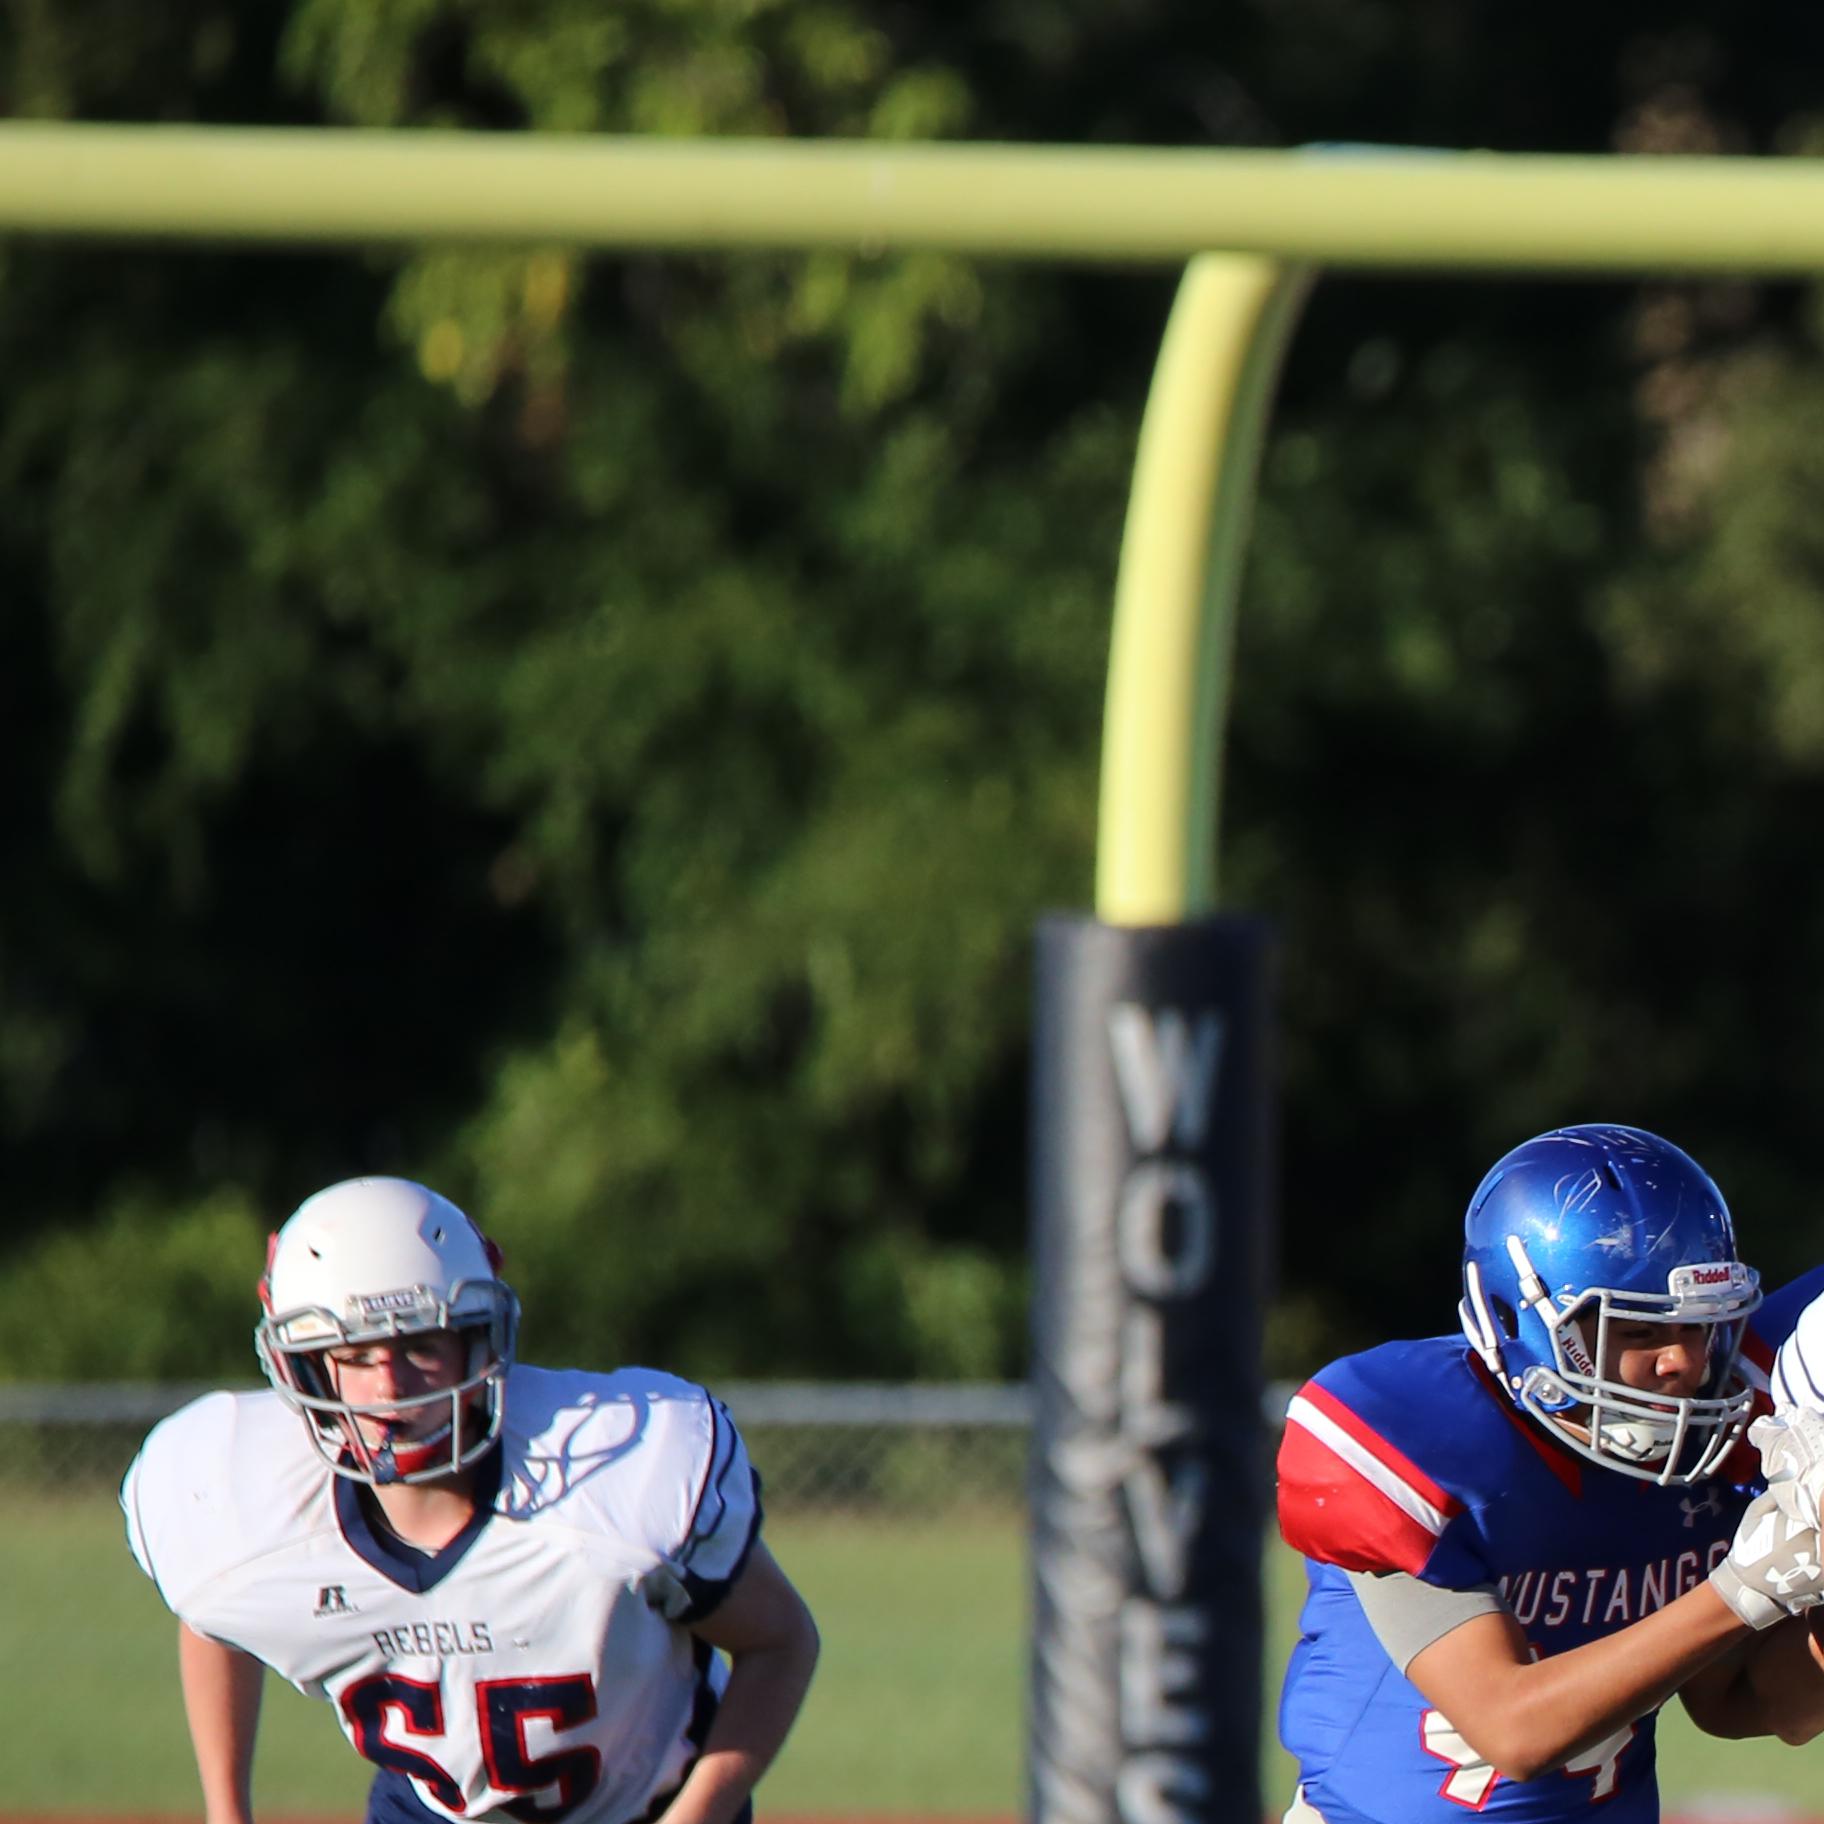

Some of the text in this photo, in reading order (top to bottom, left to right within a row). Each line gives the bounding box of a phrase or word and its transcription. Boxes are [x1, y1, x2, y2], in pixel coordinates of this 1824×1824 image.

[1692, 1266, 1730, 1285] Riddell
[1561, 1336, 1596, 1378] Ridde
[371, 1621, 494, 1660] REBELS
